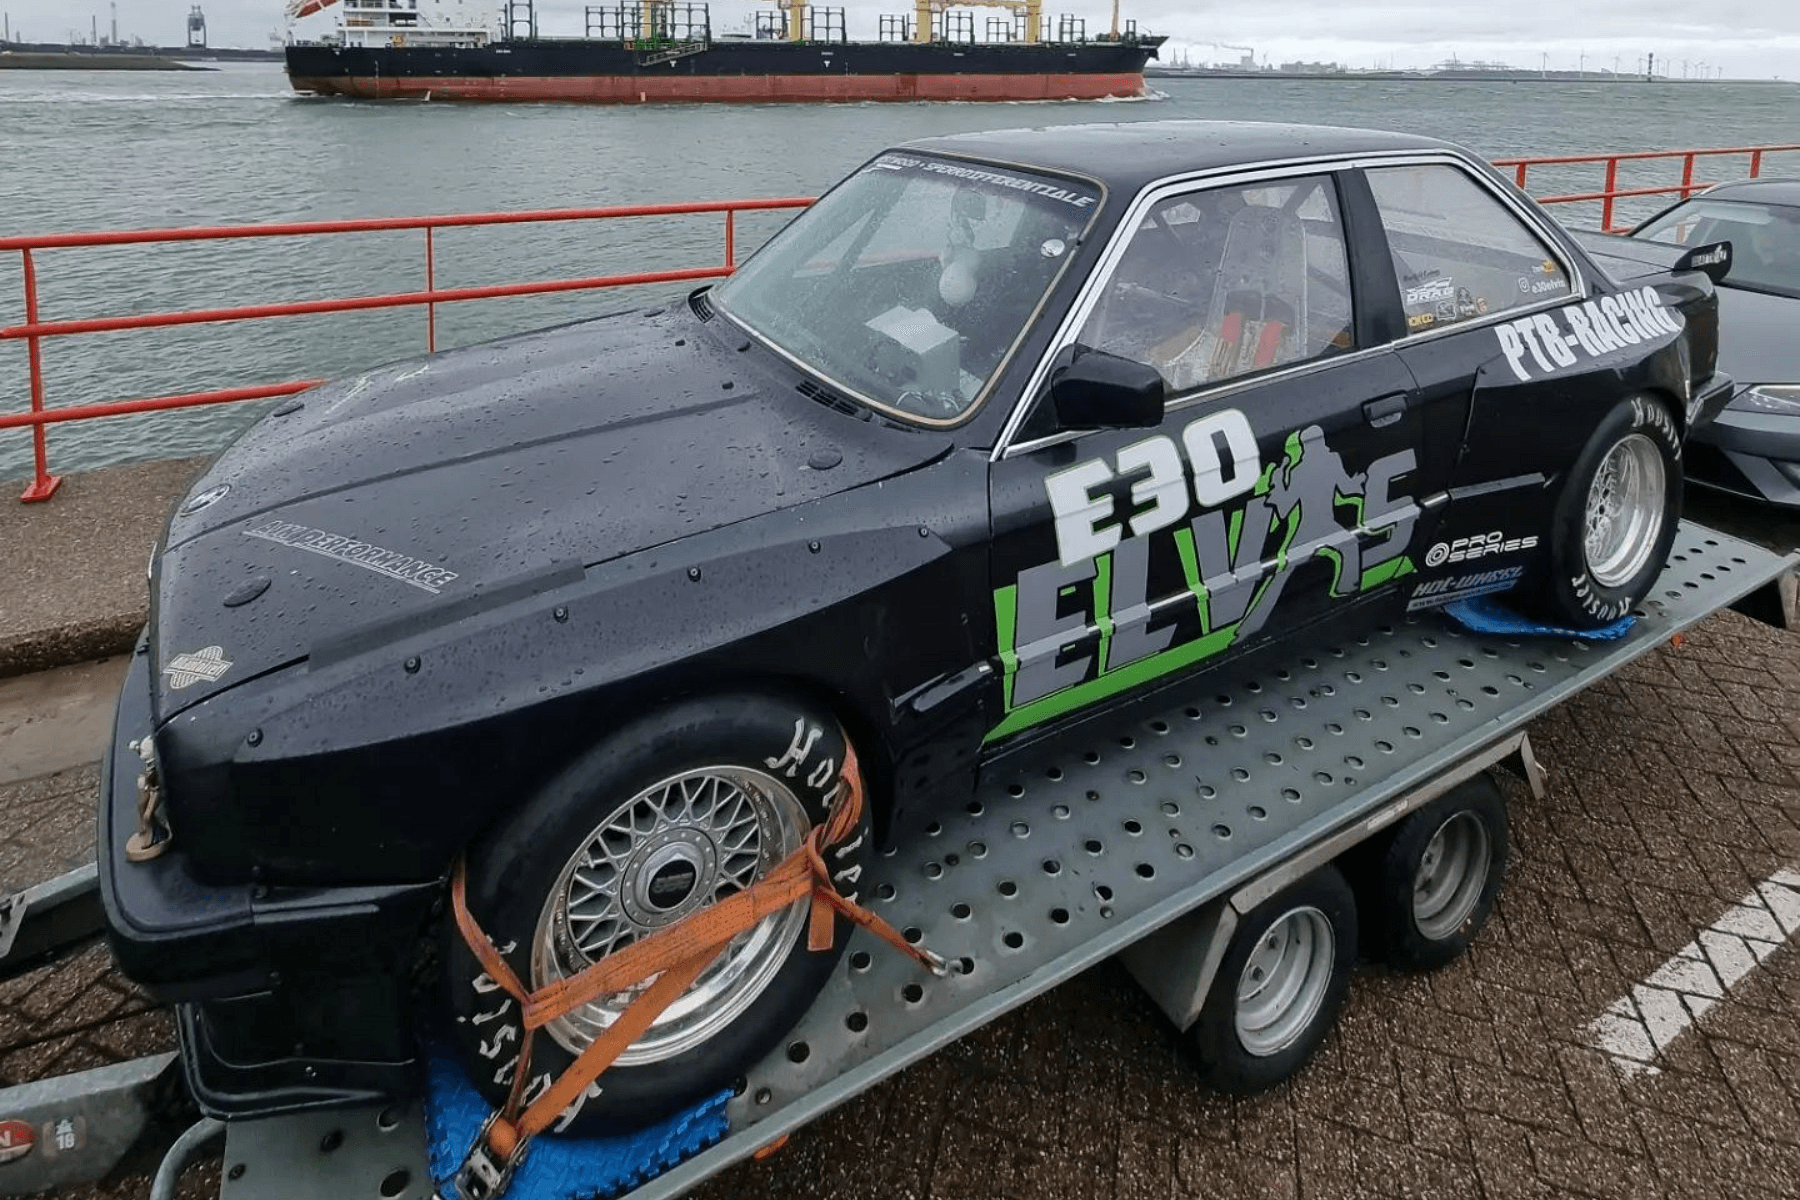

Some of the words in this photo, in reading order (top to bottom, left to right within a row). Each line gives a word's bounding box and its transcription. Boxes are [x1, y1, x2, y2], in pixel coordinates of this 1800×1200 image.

[1494, 285, 1682, 382] PTB-RACING
[1044, 407, 1261, 569] E30
[287, 527, 460, 588] PERFORMANCE
[1448, 535, 1540, 563] SERIES
[1451, 530, 1503, 551] PRO
